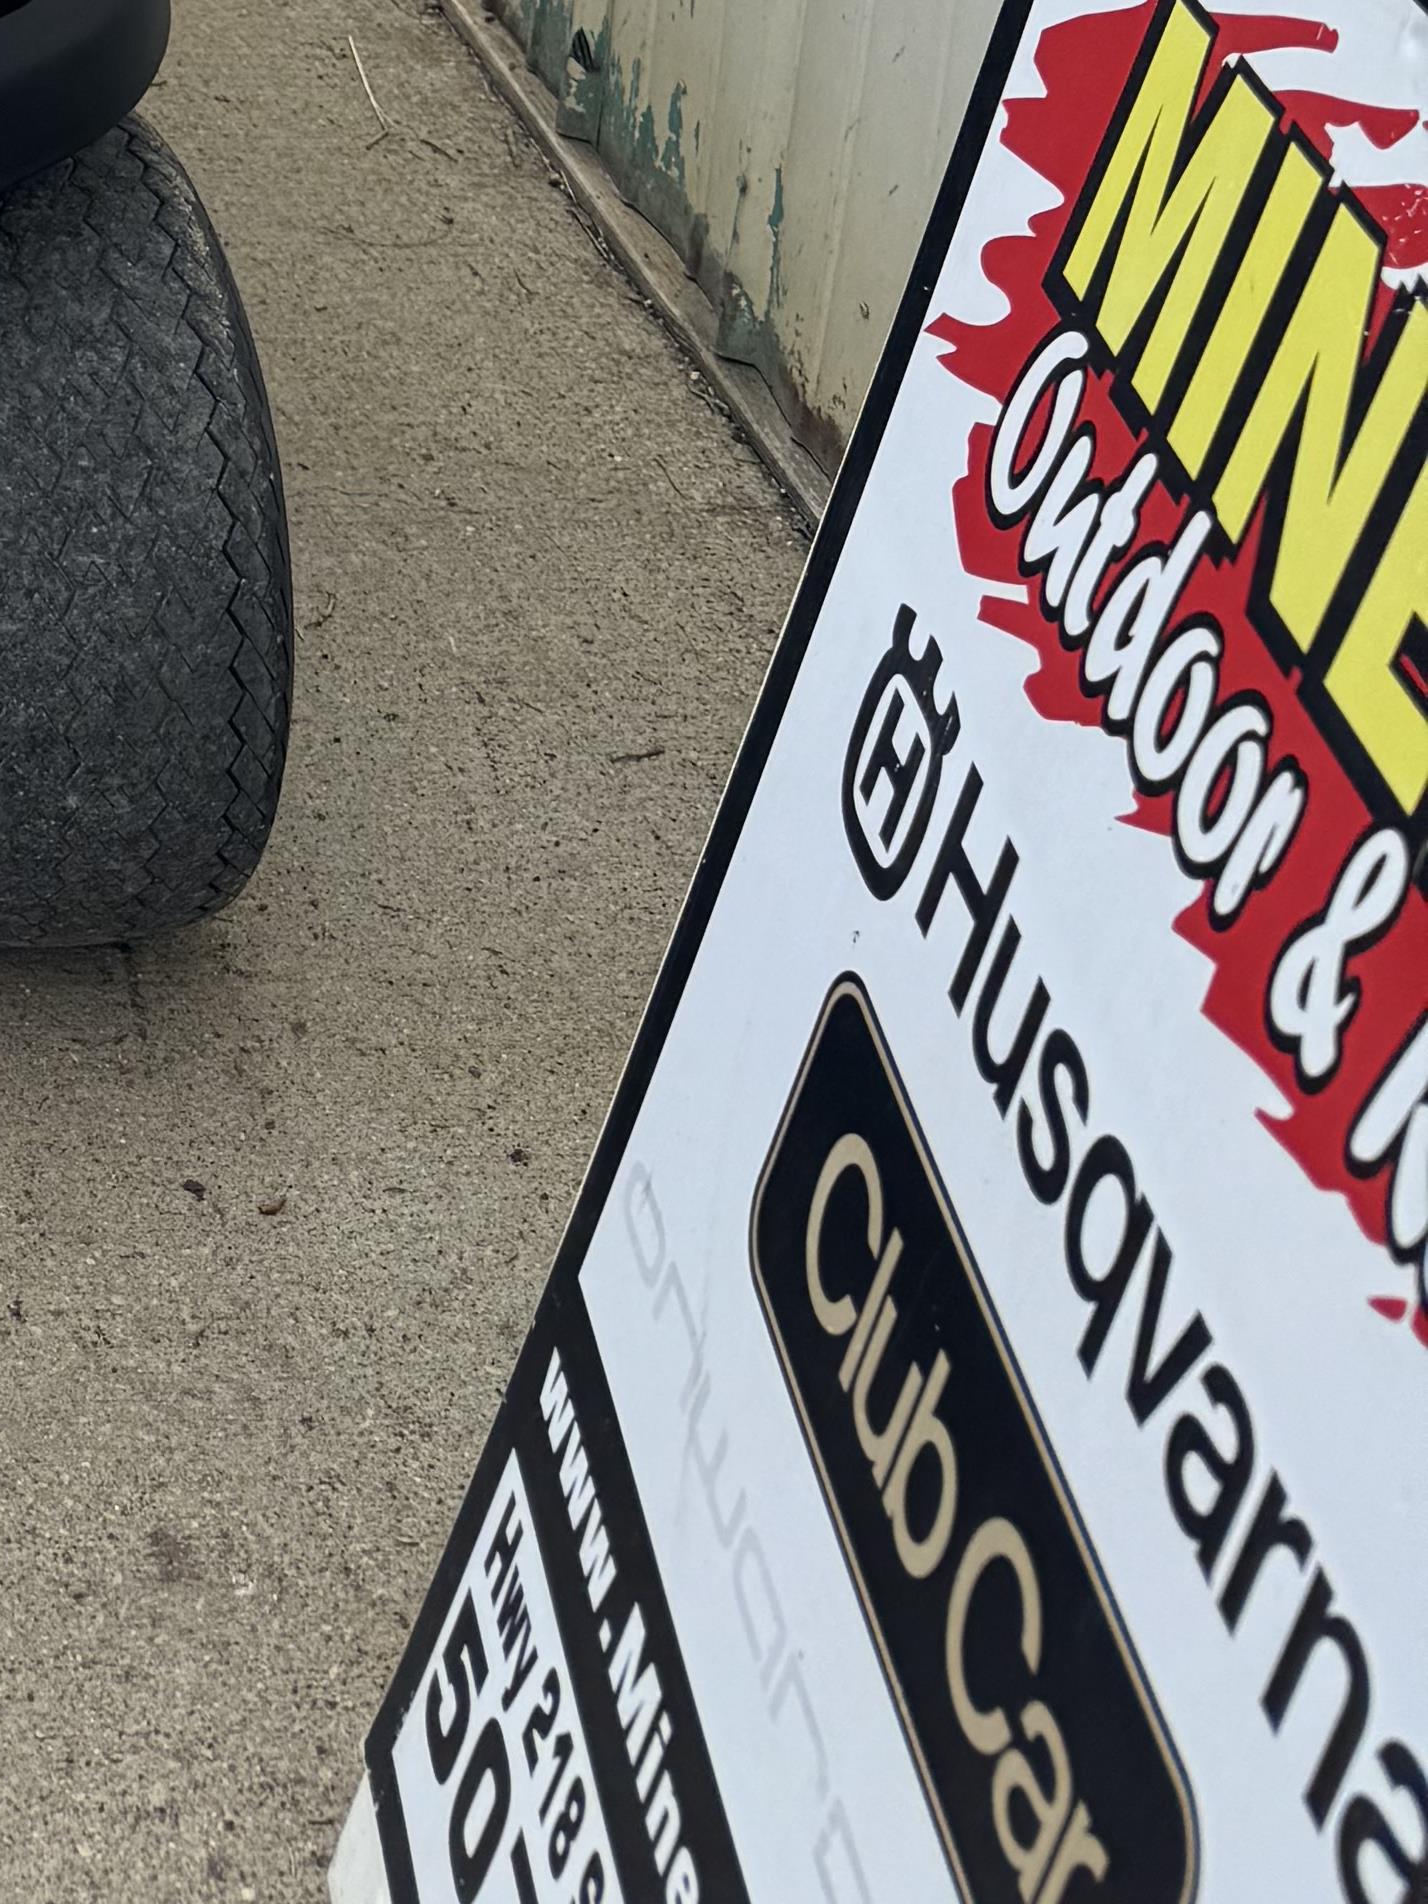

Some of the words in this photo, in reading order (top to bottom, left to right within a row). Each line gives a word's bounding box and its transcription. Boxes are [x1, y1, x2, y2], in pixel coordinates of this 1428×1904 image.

[987, 330, 1304, 918] Outdoor
[1269, 826, 1410, 1079] &
[484, 1488, 539, 1714] Hwy
[521, 1666, 587, 1882] 218
[805, 1132, 958, 1580] Club
[947, 1516, 1110, 1904] Car
[914, 760, 1428, 1904] Husqvarna
